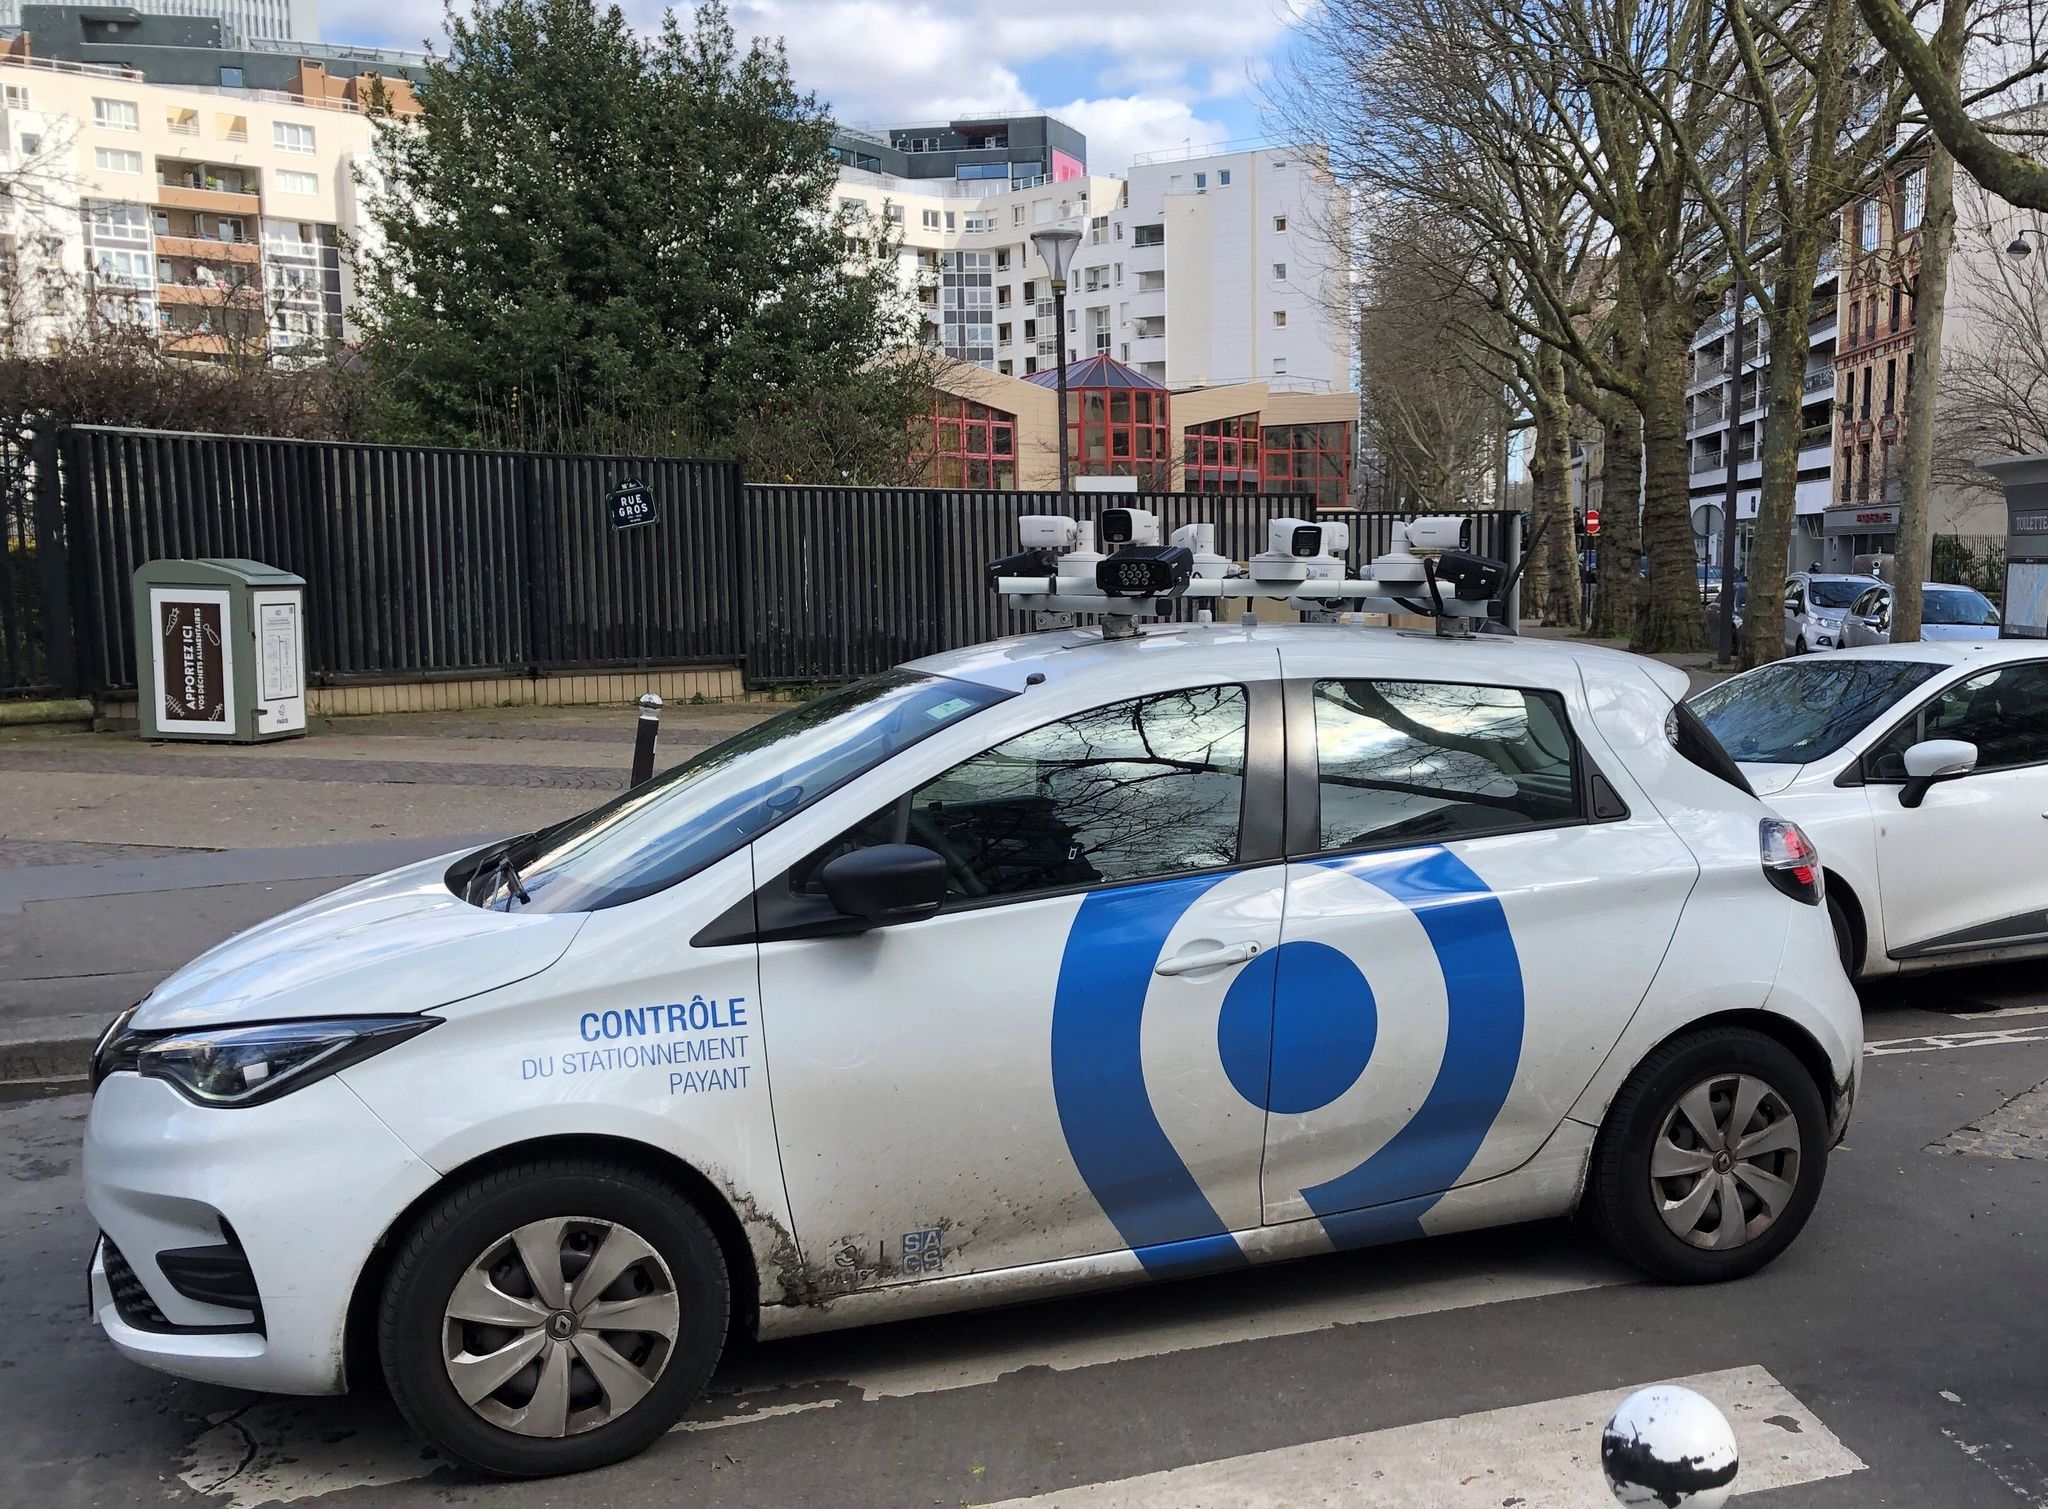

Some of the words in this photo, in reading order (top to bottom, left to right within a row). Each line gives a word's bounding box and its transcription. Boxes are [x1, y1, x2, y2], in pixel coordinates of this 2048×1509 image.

[619, 503, 648, 517] GROS
[621, 494, 642, 507] RUE
[2016, 516, 2048, 530] TOILETTE
[183, 626, 194, 643] ICI
[194, 608, 203, 661] ALIMENTAIRES
[182, 645, 196, 710] APPORTEZ
[580, 994, 748, 1042] CONTRÔLE
[522, 1056, 554, 1080] DU
[562, 1035, 749, 1075] STATIONNEMENT
[670, 1065, 751, 1095] PAYANT
